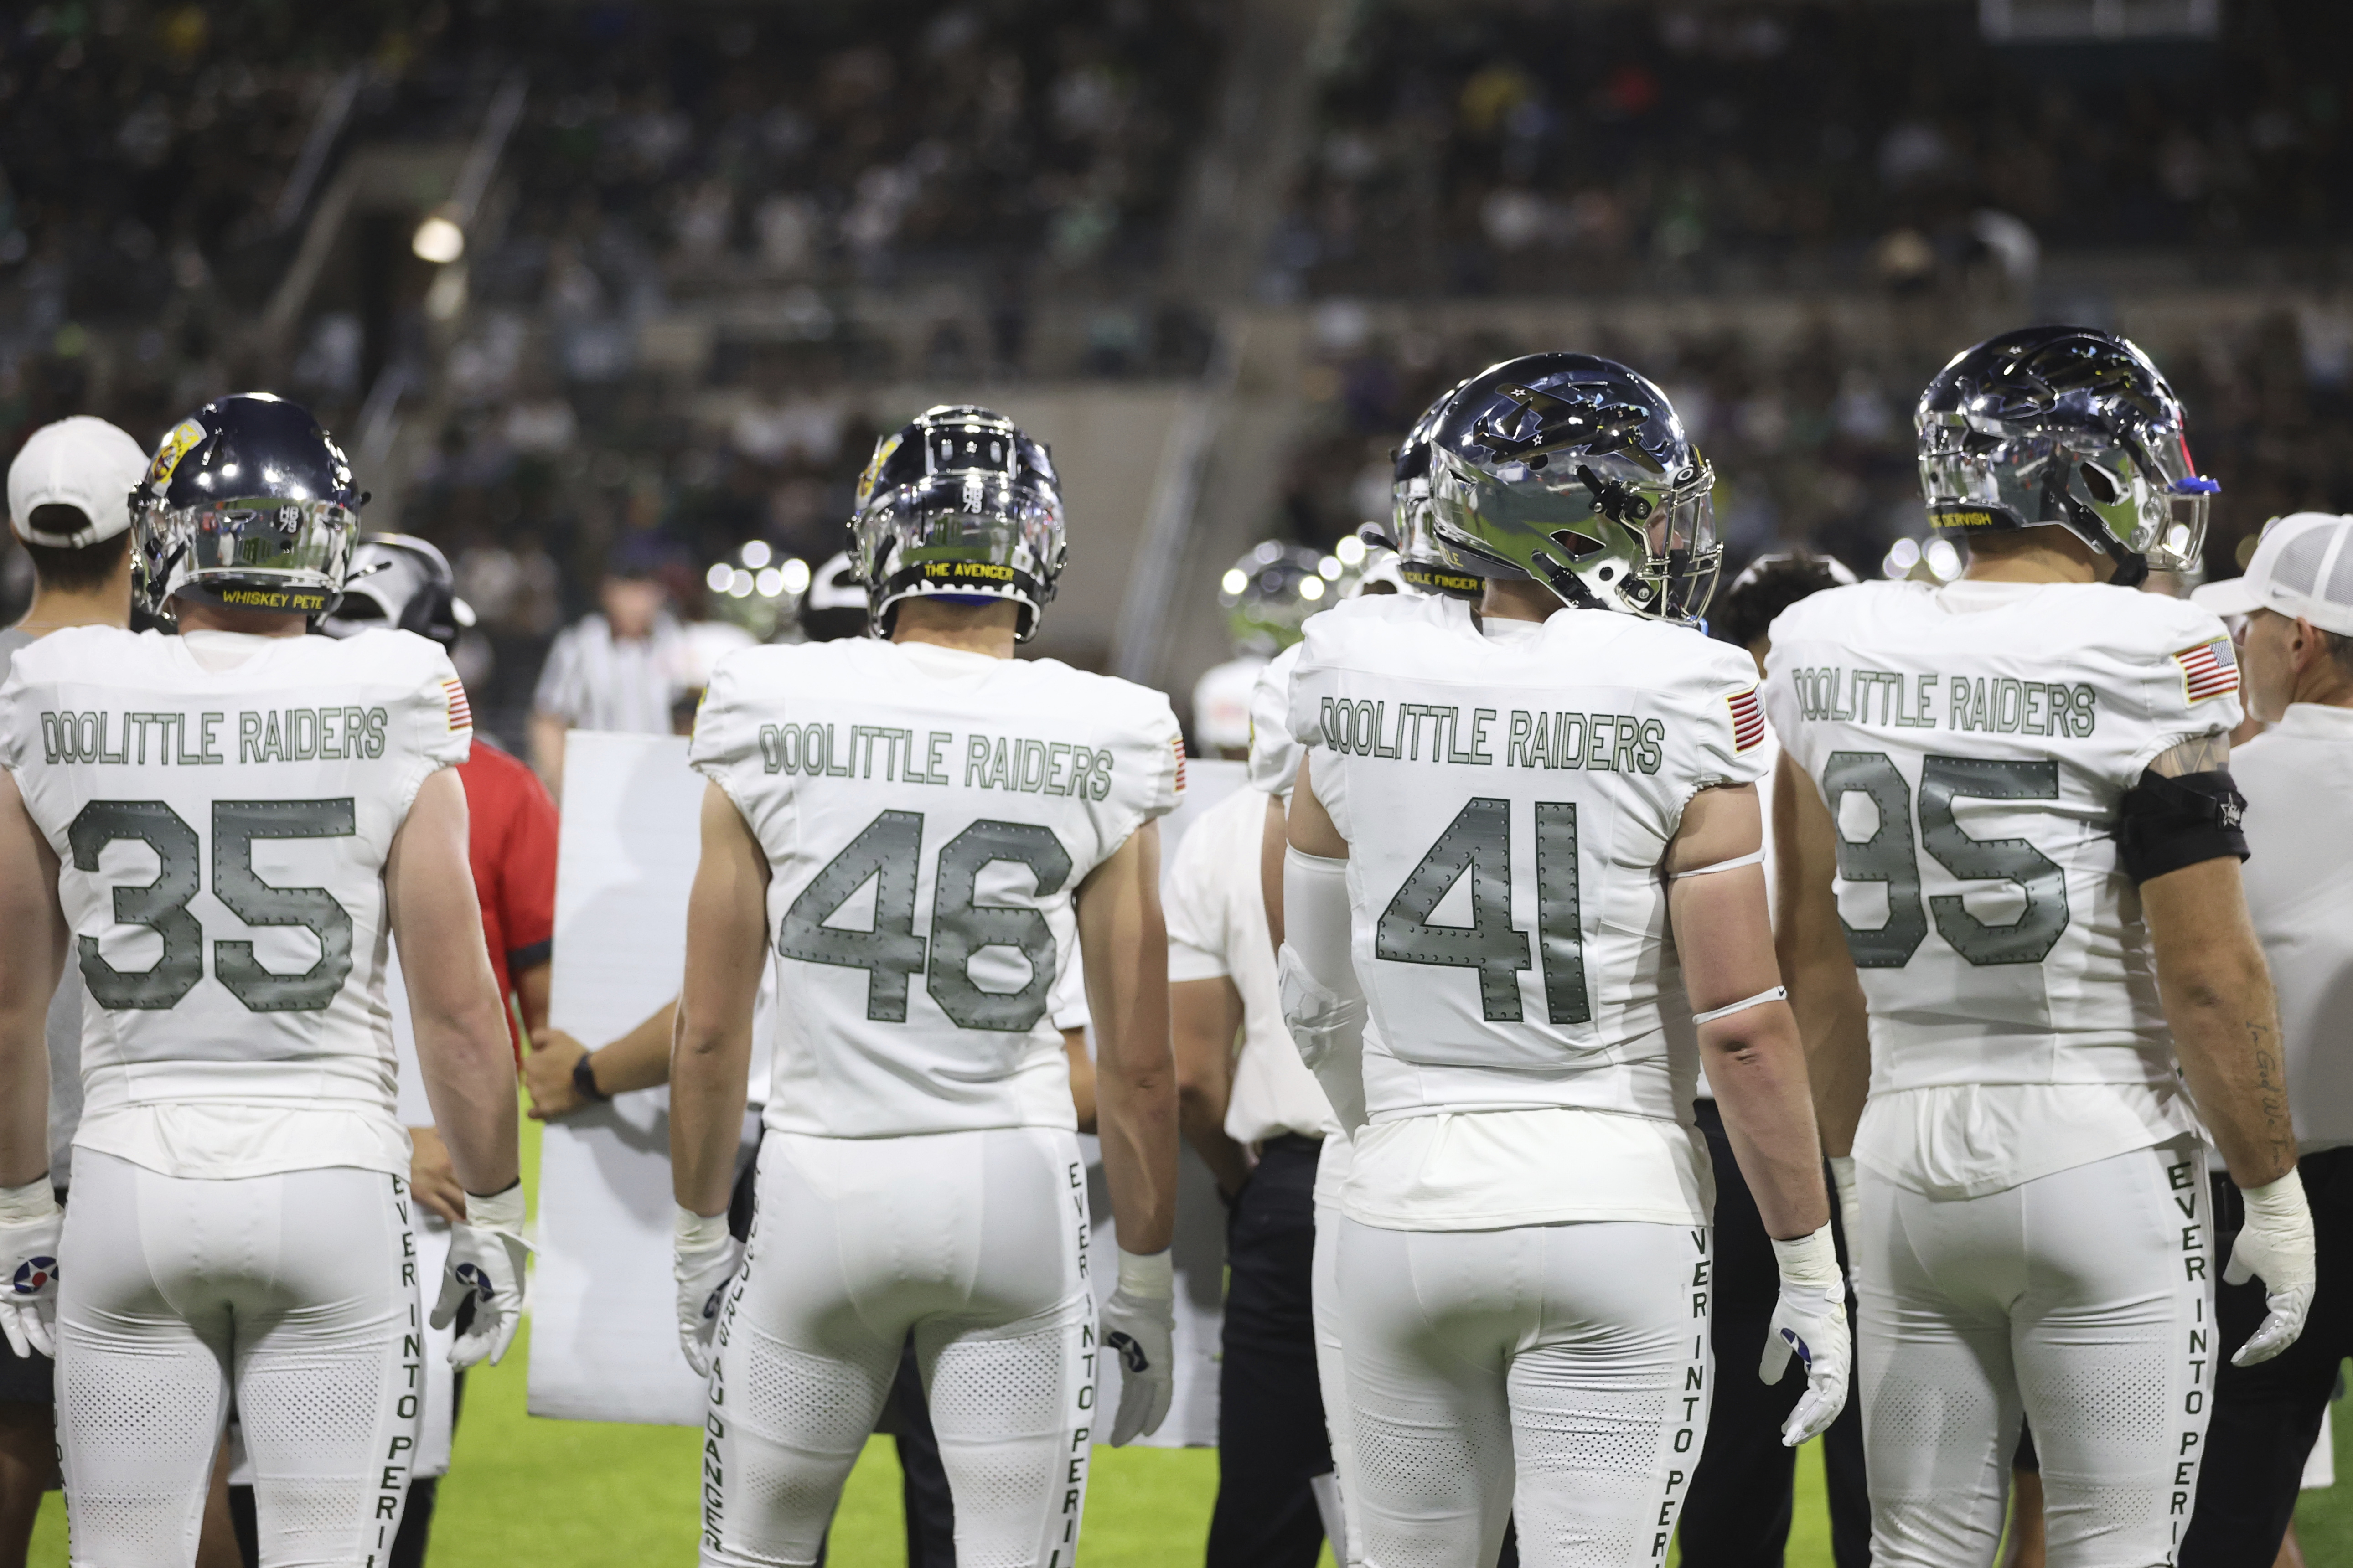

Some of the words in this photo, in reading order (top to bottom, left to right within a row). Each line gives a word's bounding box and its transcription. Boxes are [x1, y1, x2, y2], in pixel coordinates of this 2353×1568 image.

[279, 505, 299, 523] HB
[279, 520, 297, 533] 79
[962, 486, 983, 503] HB
[962, 500, 982, 514] 79
[1941, 511, 1993, 527] DERVISH
[223, 590, 290, 607] WHISKEY
[293, 594, 325, 610] PETE
[924, 562, 951, 578] THE
[954, 562, 1014, 582] AVENGER
[1434, 574, 1478, 591] FINGER
[41, 711, 224, 765] DOOLITTLE
[240, 706, 388, 764] RAIDERS
[1320, 696, 1497, 765] DOOLITTLE
[1507, 710, 1665, 775] RAIDERS
[1949, 676, 2095, 738] RAIDERS
[760, 723, 952, 785] DOOLITTLE
[965, 735, 1114, 801] RAIDERS
[1823, 751, 2070, 968] 95
[67, 797, 356, 1012] 35
[778, 809, 1073, 1032] 46
[1375, 797, 1592, 1024] 41
[392, 1174, 416, 1287] EVER
[2167, 1161, 2207, 1281] EVER
[1069, 1161, 1089, 1279] EVER
[1079, 1293, 1095, 1410] INTO
[1691, 1228, 1711, 1318] VER
[397, 1304, 421, 1419] INTO
[709, 1356, 724, 1405] AU
[1674, 1335, 1704, 1453] INTO
[2185, 1299, 2207, 1415] INTO
[704, 1410, 725, 1553] DANGER
